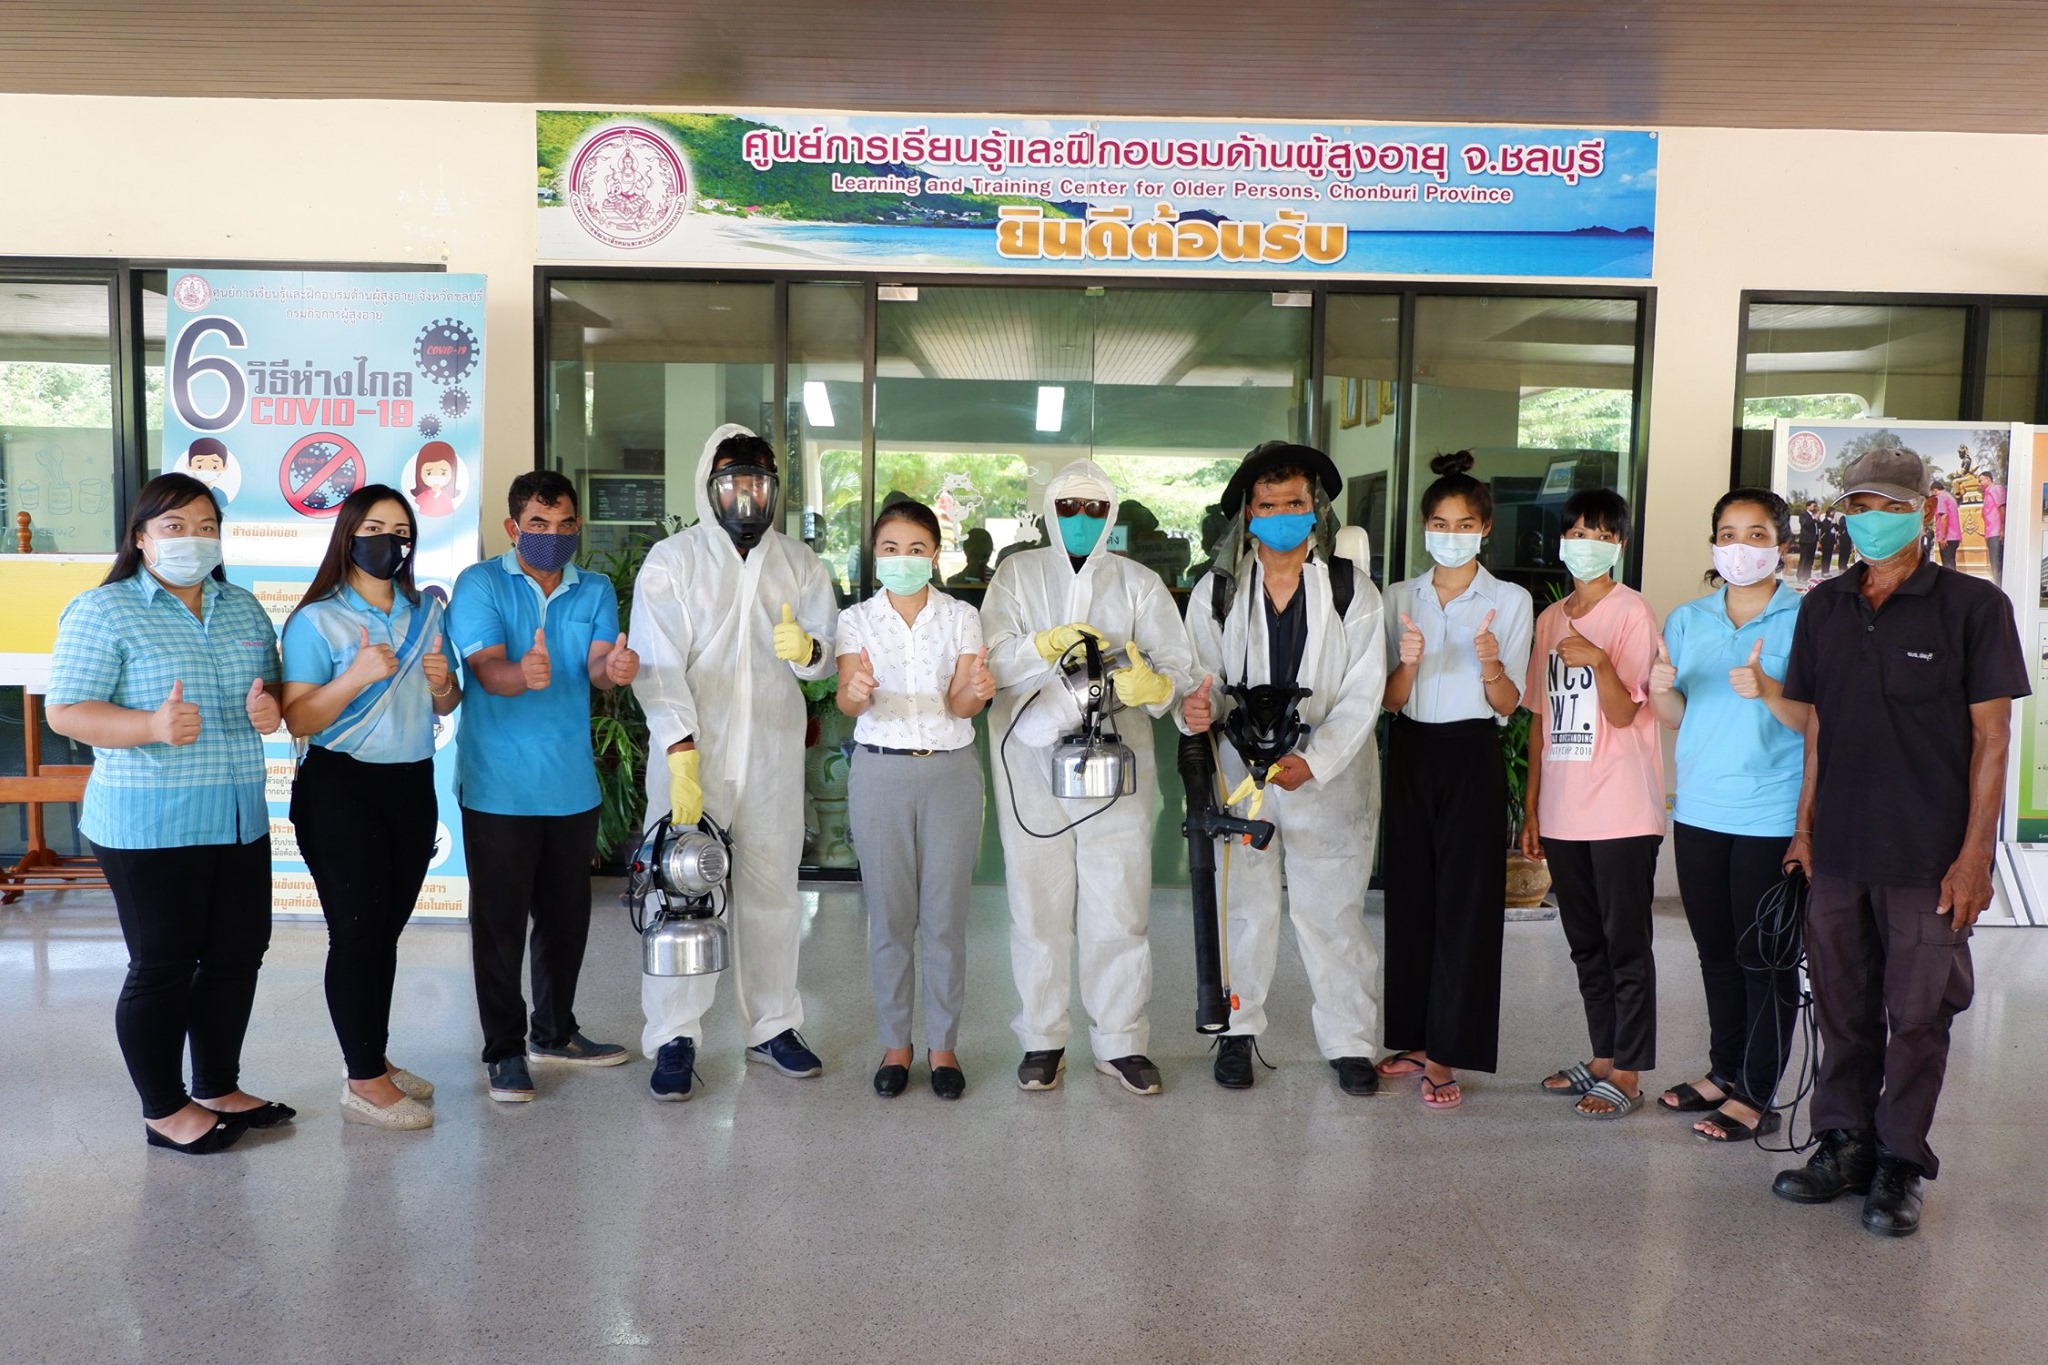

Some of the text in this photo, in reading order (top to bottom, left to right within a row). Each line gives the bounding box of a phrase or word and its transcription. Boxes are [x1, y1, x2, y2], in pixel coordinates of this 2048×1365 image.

[744, 129, 1603, 182] ศูนย์การเรียนรู้และฝึกอบรมด้านผู้สูงอายุ จ.ชลบุรี
[833, 175, 1513, 202] Learning and Training Center for Older Persons, Chonburi Province
[999, 204, 1345, 261] ยินดีต้อนรับ
[212, 286, 483, 305] ศูนย์การเรียนรู้และฝึกอบรมด้านผู้สูงอายุ จังหวัดชลบุรี
[286, 306, 383, 324] กรมกิจการผู้สูงอายุ
[172, 316, 247, 432] 6
[247, 356, 413, 398] วิธีห่างไกล
[250, 397, 414, 428] COVID-19
